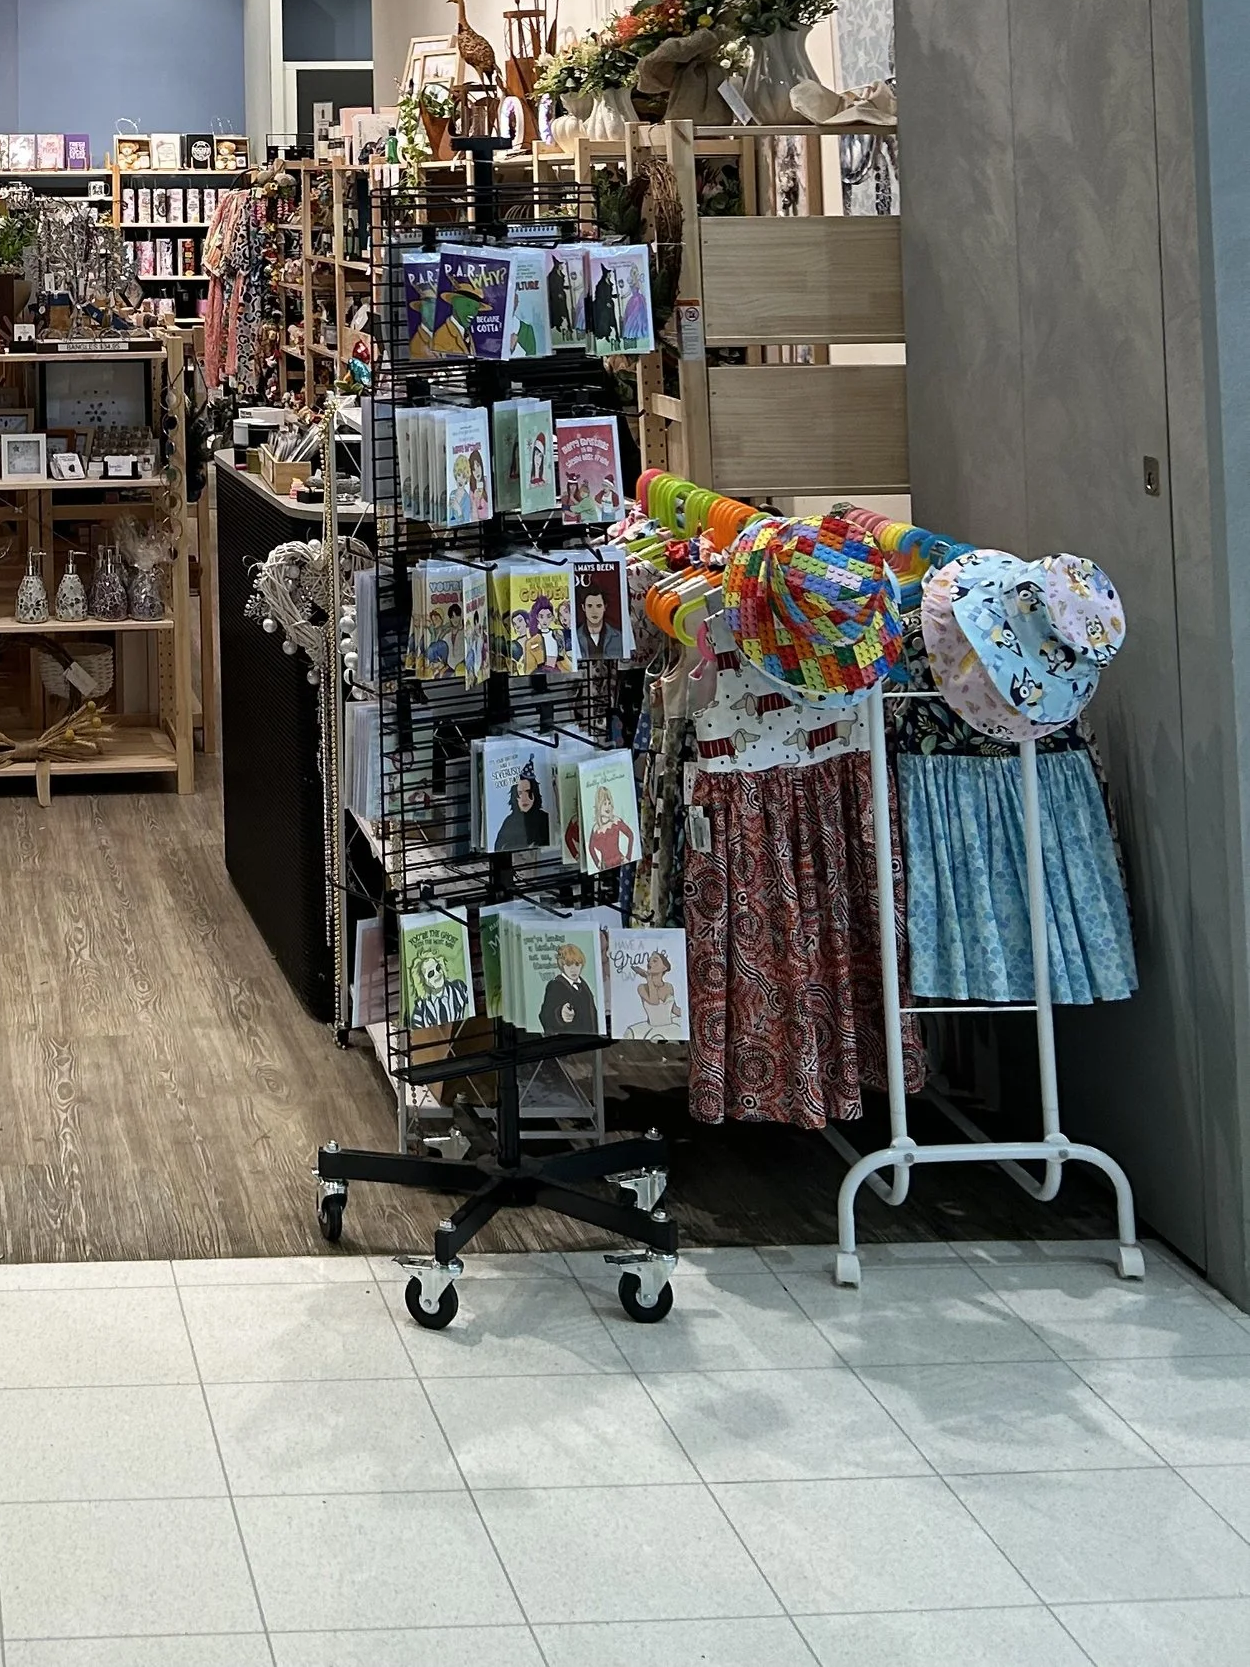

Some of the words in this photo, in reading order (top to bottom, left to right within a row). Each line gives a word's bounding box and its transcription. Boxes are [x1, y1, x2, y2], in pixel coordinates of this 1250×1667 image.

[469, 267, 507, 290] WHY?
[574, 564, 596, 572] LWAYS
[596, 563, 615, 572] BEEN
[519, 586, 570, 603] GOLDEN
[429, 929, 440, 938] THE
[441, 931, 459, 945] GHOST
[614, 939, 635, 951] HAVE
[638, 940, 645, 951] A
